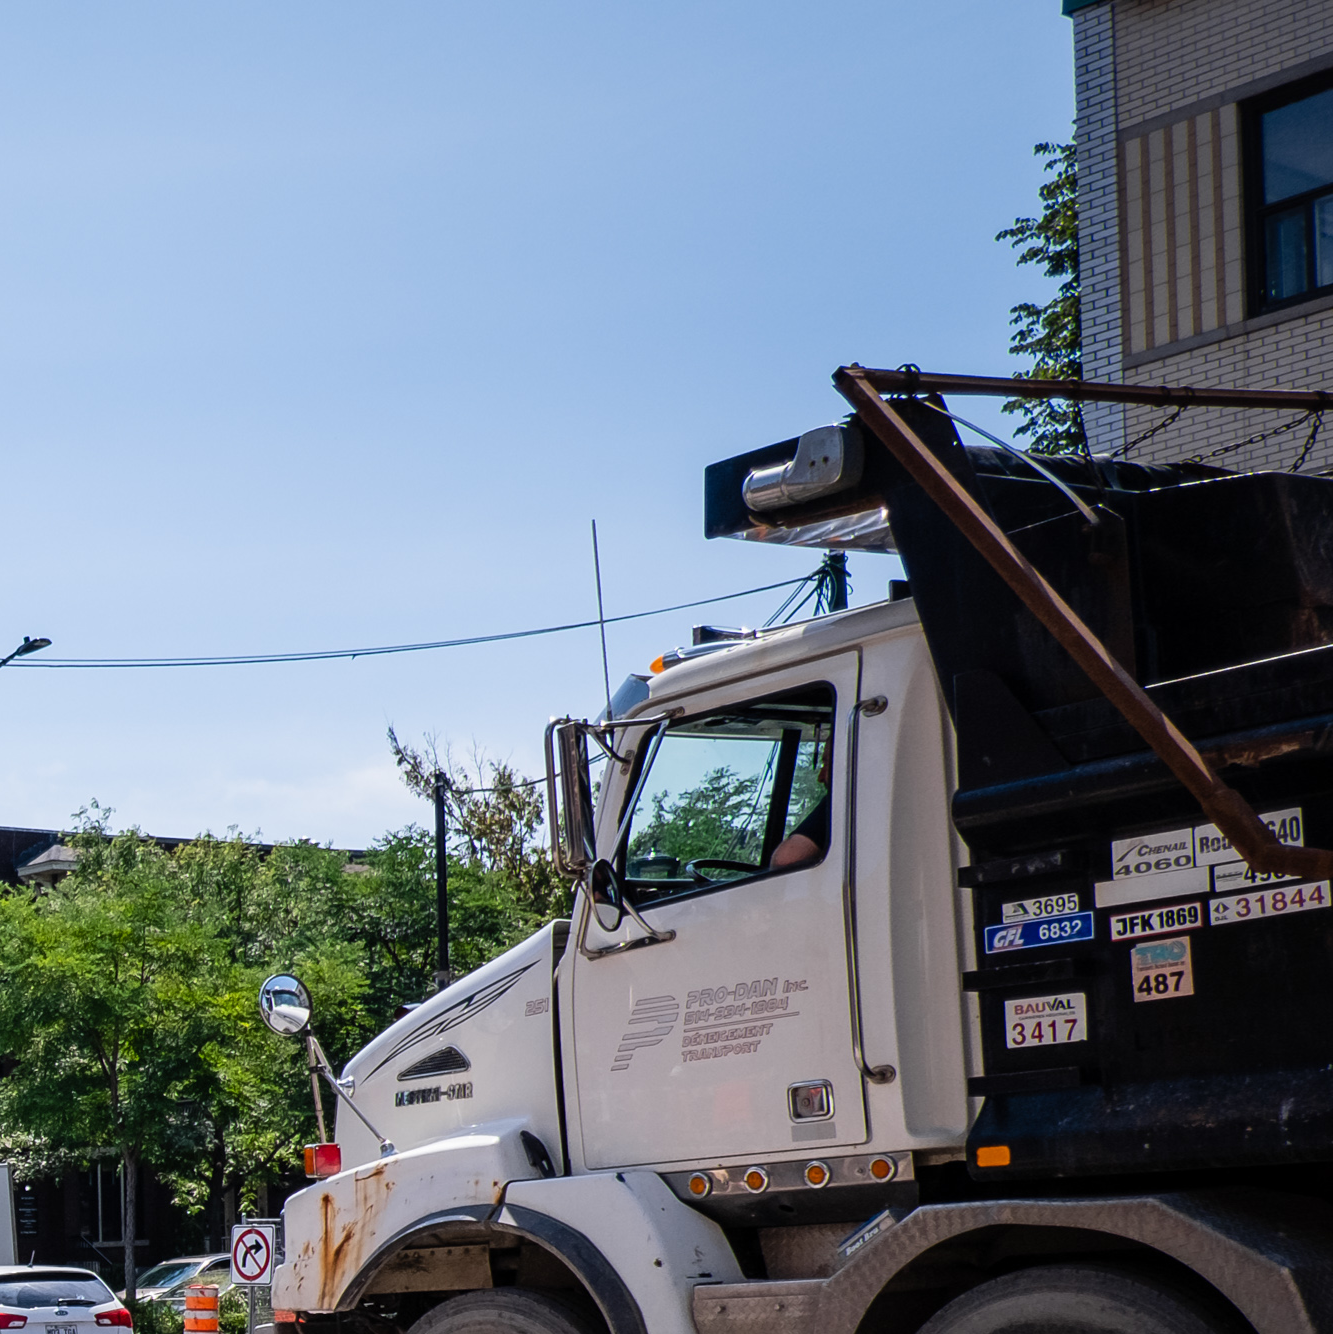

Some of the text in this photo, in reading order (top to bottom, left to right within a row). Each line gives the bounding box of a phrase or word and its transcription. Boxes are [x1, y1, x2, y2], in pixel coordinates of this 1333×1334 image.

[1136, 842, 1188, 857] CHENAIL
[1114, 855, 1192, 876] 4060
[1032, 895, 1078, 917] 3695
[1235, 885, 1326, 918] 31844
[1116, 906, 1199, 937] JFK 1869
[993, 928, 1025, 948] GFL
[686, 977, 778, 1009] PRO-DAN
[1137, 970, 1185, 996] 487
[525, 997, 550, 1017] 251
[1014, 998, 1076, 1015] BAUVAL
[1011, 1018, 1078, 1046] 3417
[681, 1040, 761, 1063] TRANSPORT
